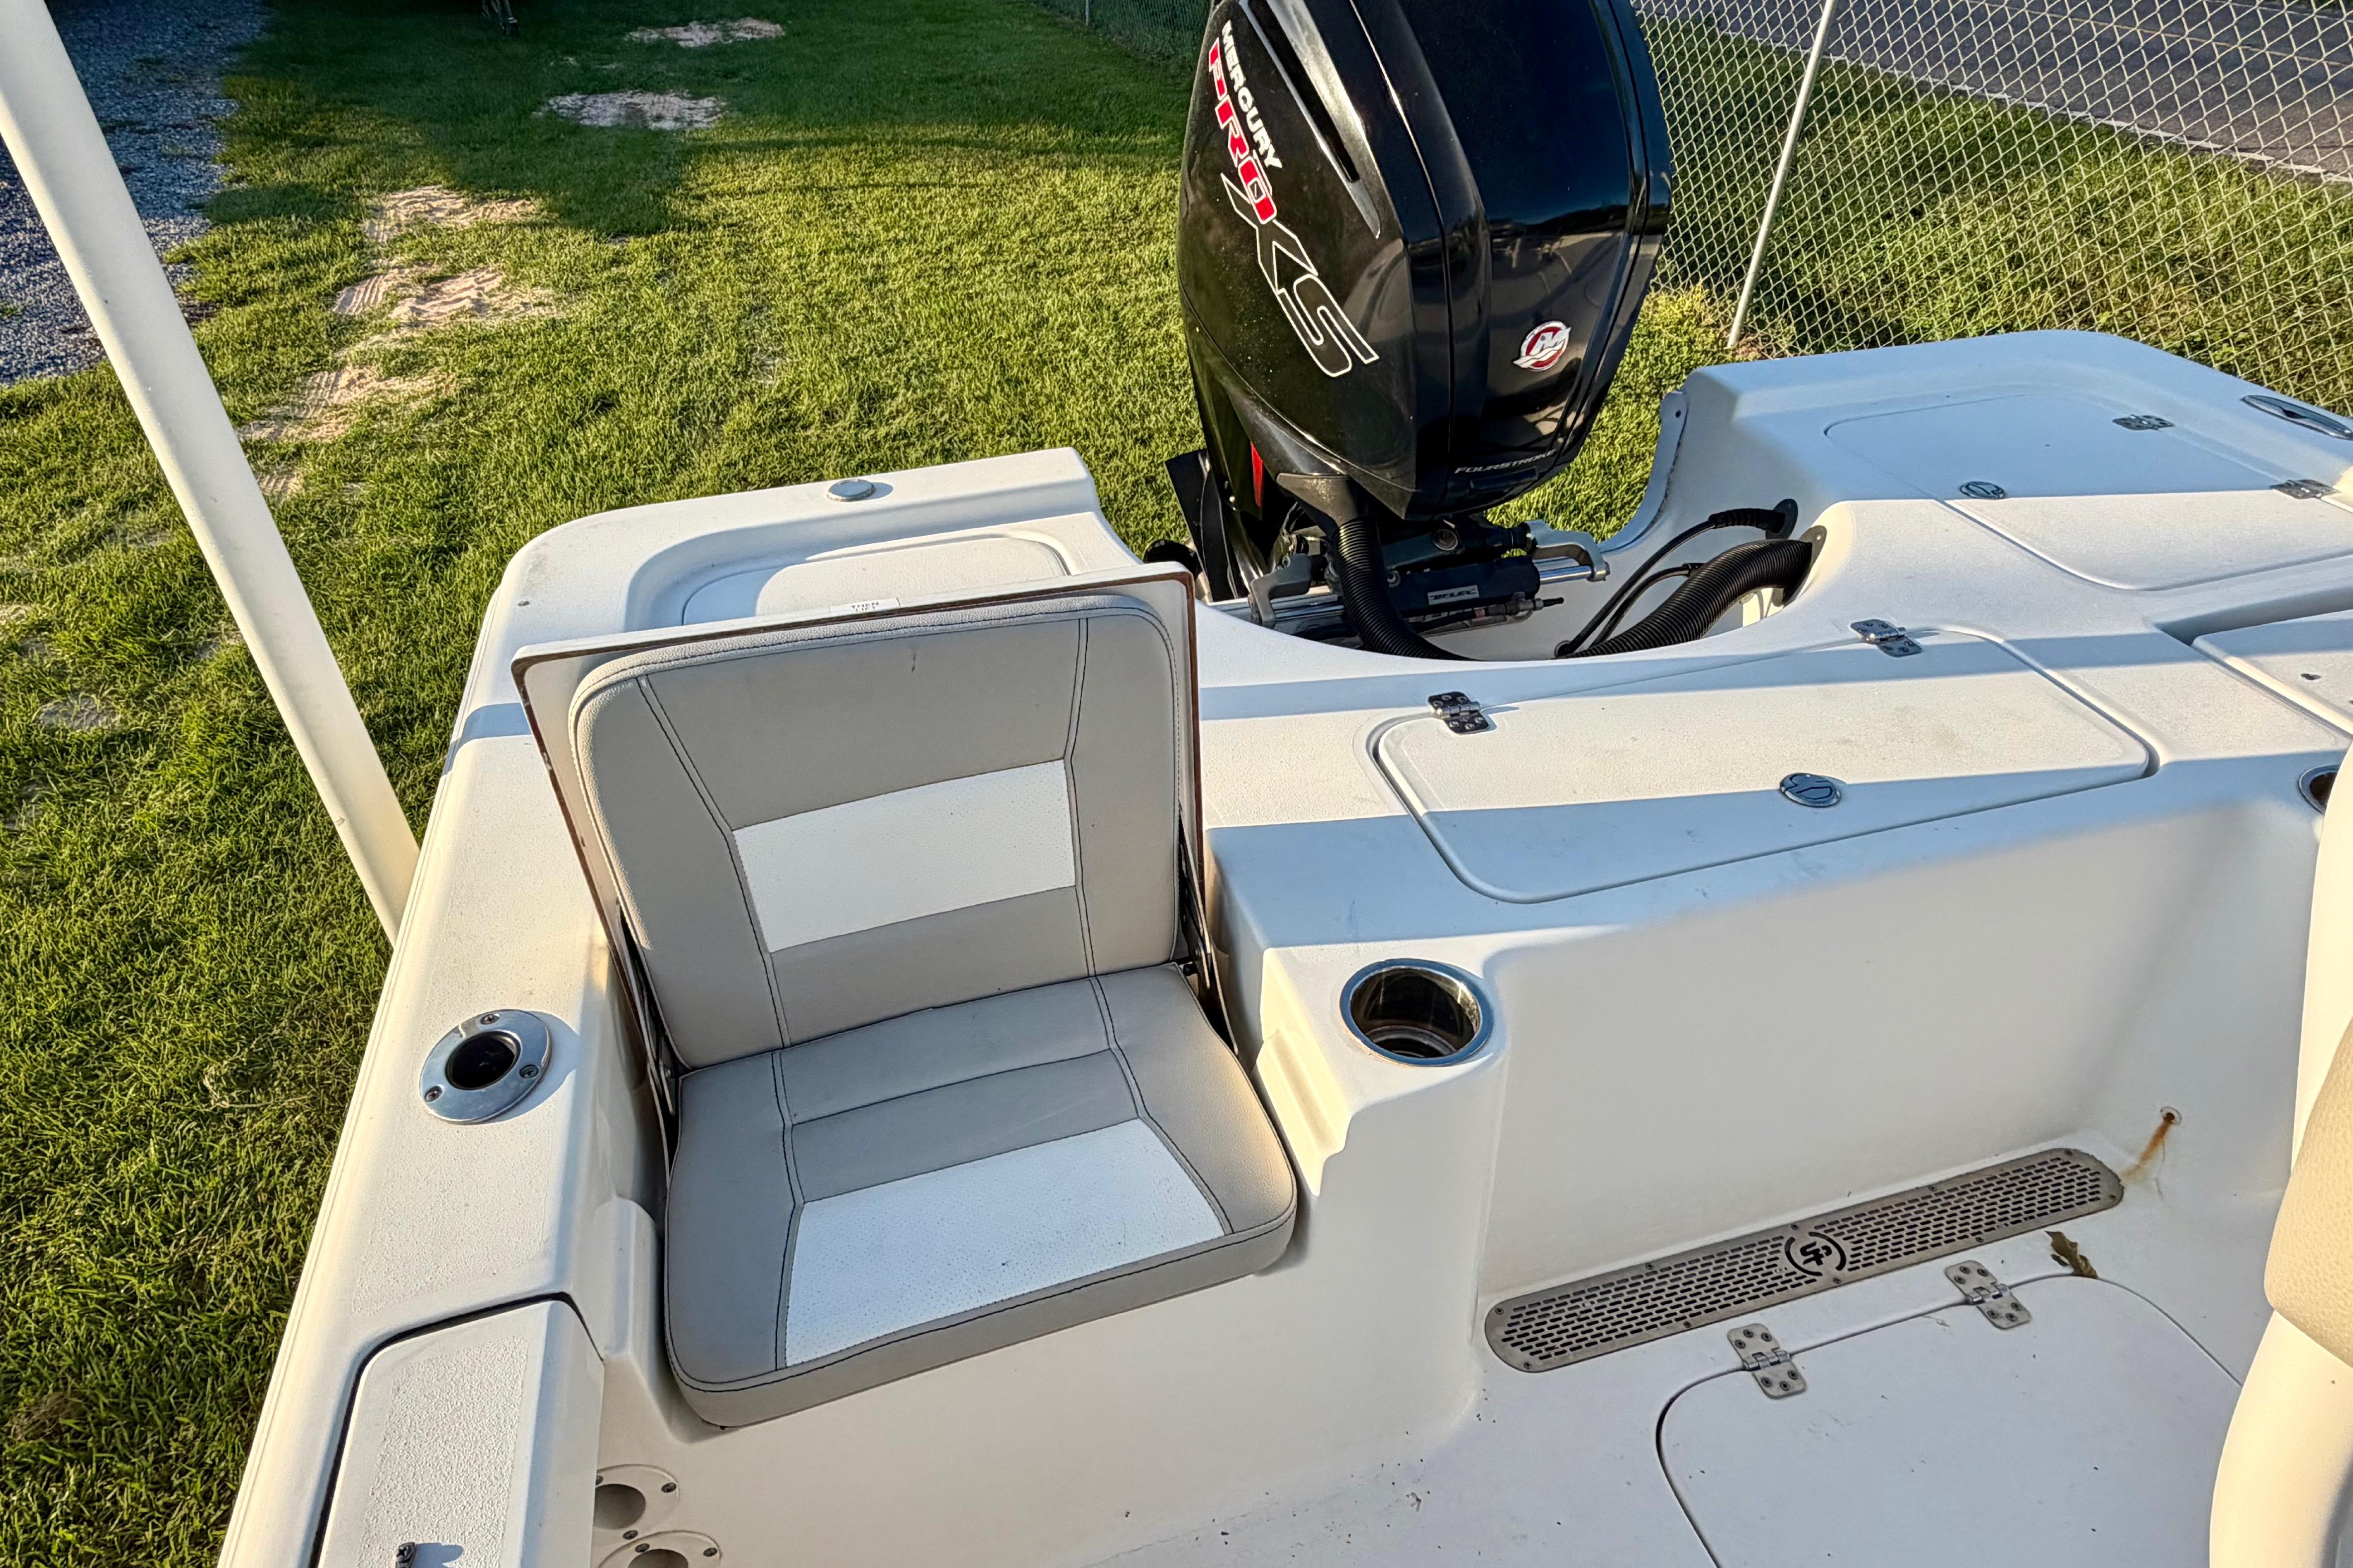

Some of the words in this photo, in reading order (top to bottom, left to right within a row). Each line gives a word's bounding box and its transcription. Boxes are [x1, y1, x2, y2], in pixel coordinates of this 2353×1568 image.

[1209, 37, 1277, 225] PRO
[1222, 19, 1282, 168] MERCURY
[1221, 172, 1380, 377] XS
[1454, 449, 1556, 474] FOURSTROKE
